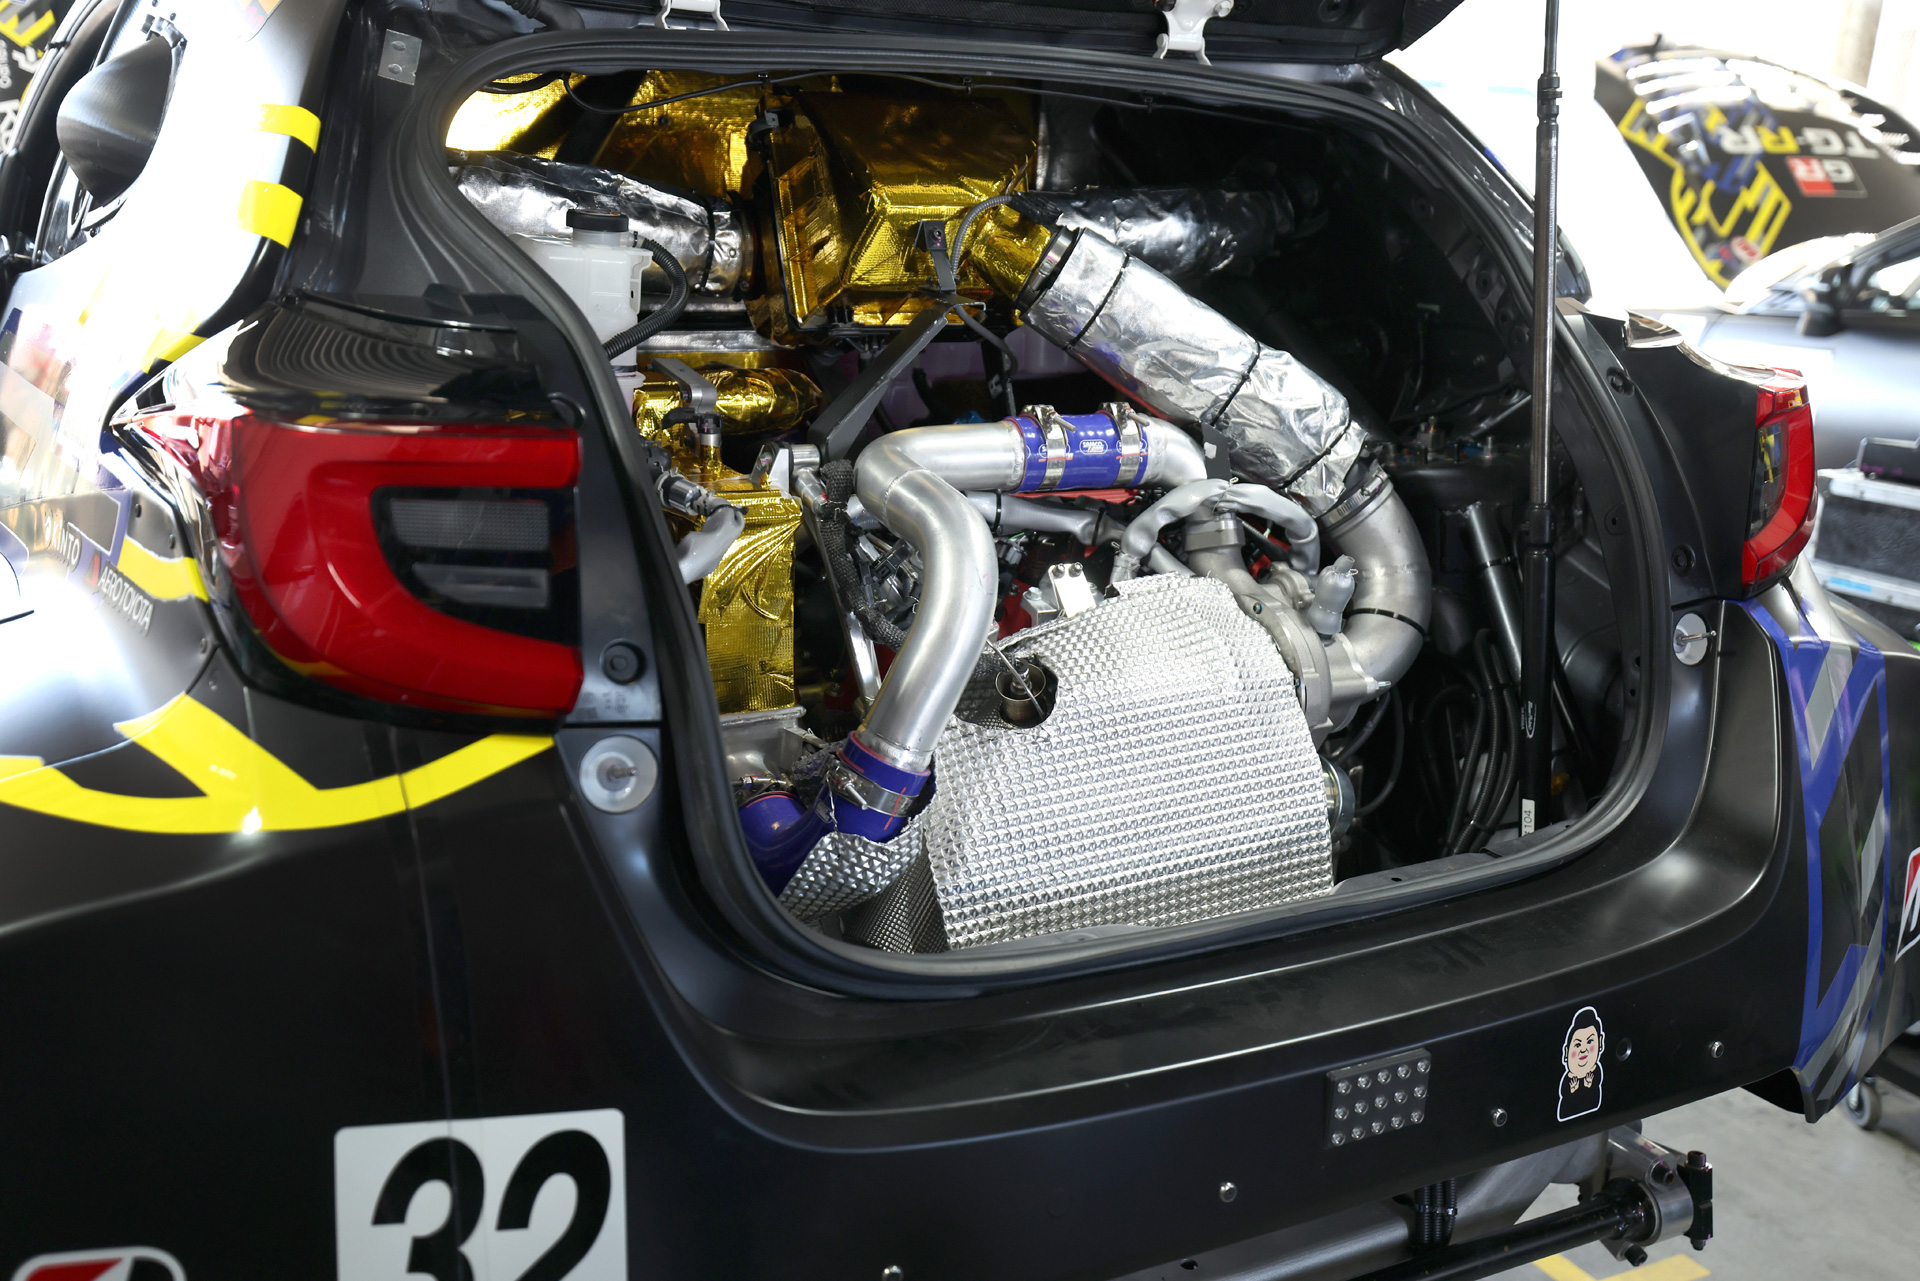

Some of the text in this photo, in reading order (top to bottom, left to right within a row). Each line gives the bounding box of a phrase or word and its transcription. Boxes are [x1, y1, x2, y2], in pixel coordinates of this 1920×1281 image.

[1788, 157, 1855, 183] GR
[51, 519, 80, 565] KINTO
[371, 1129, 611, 1281] 32
